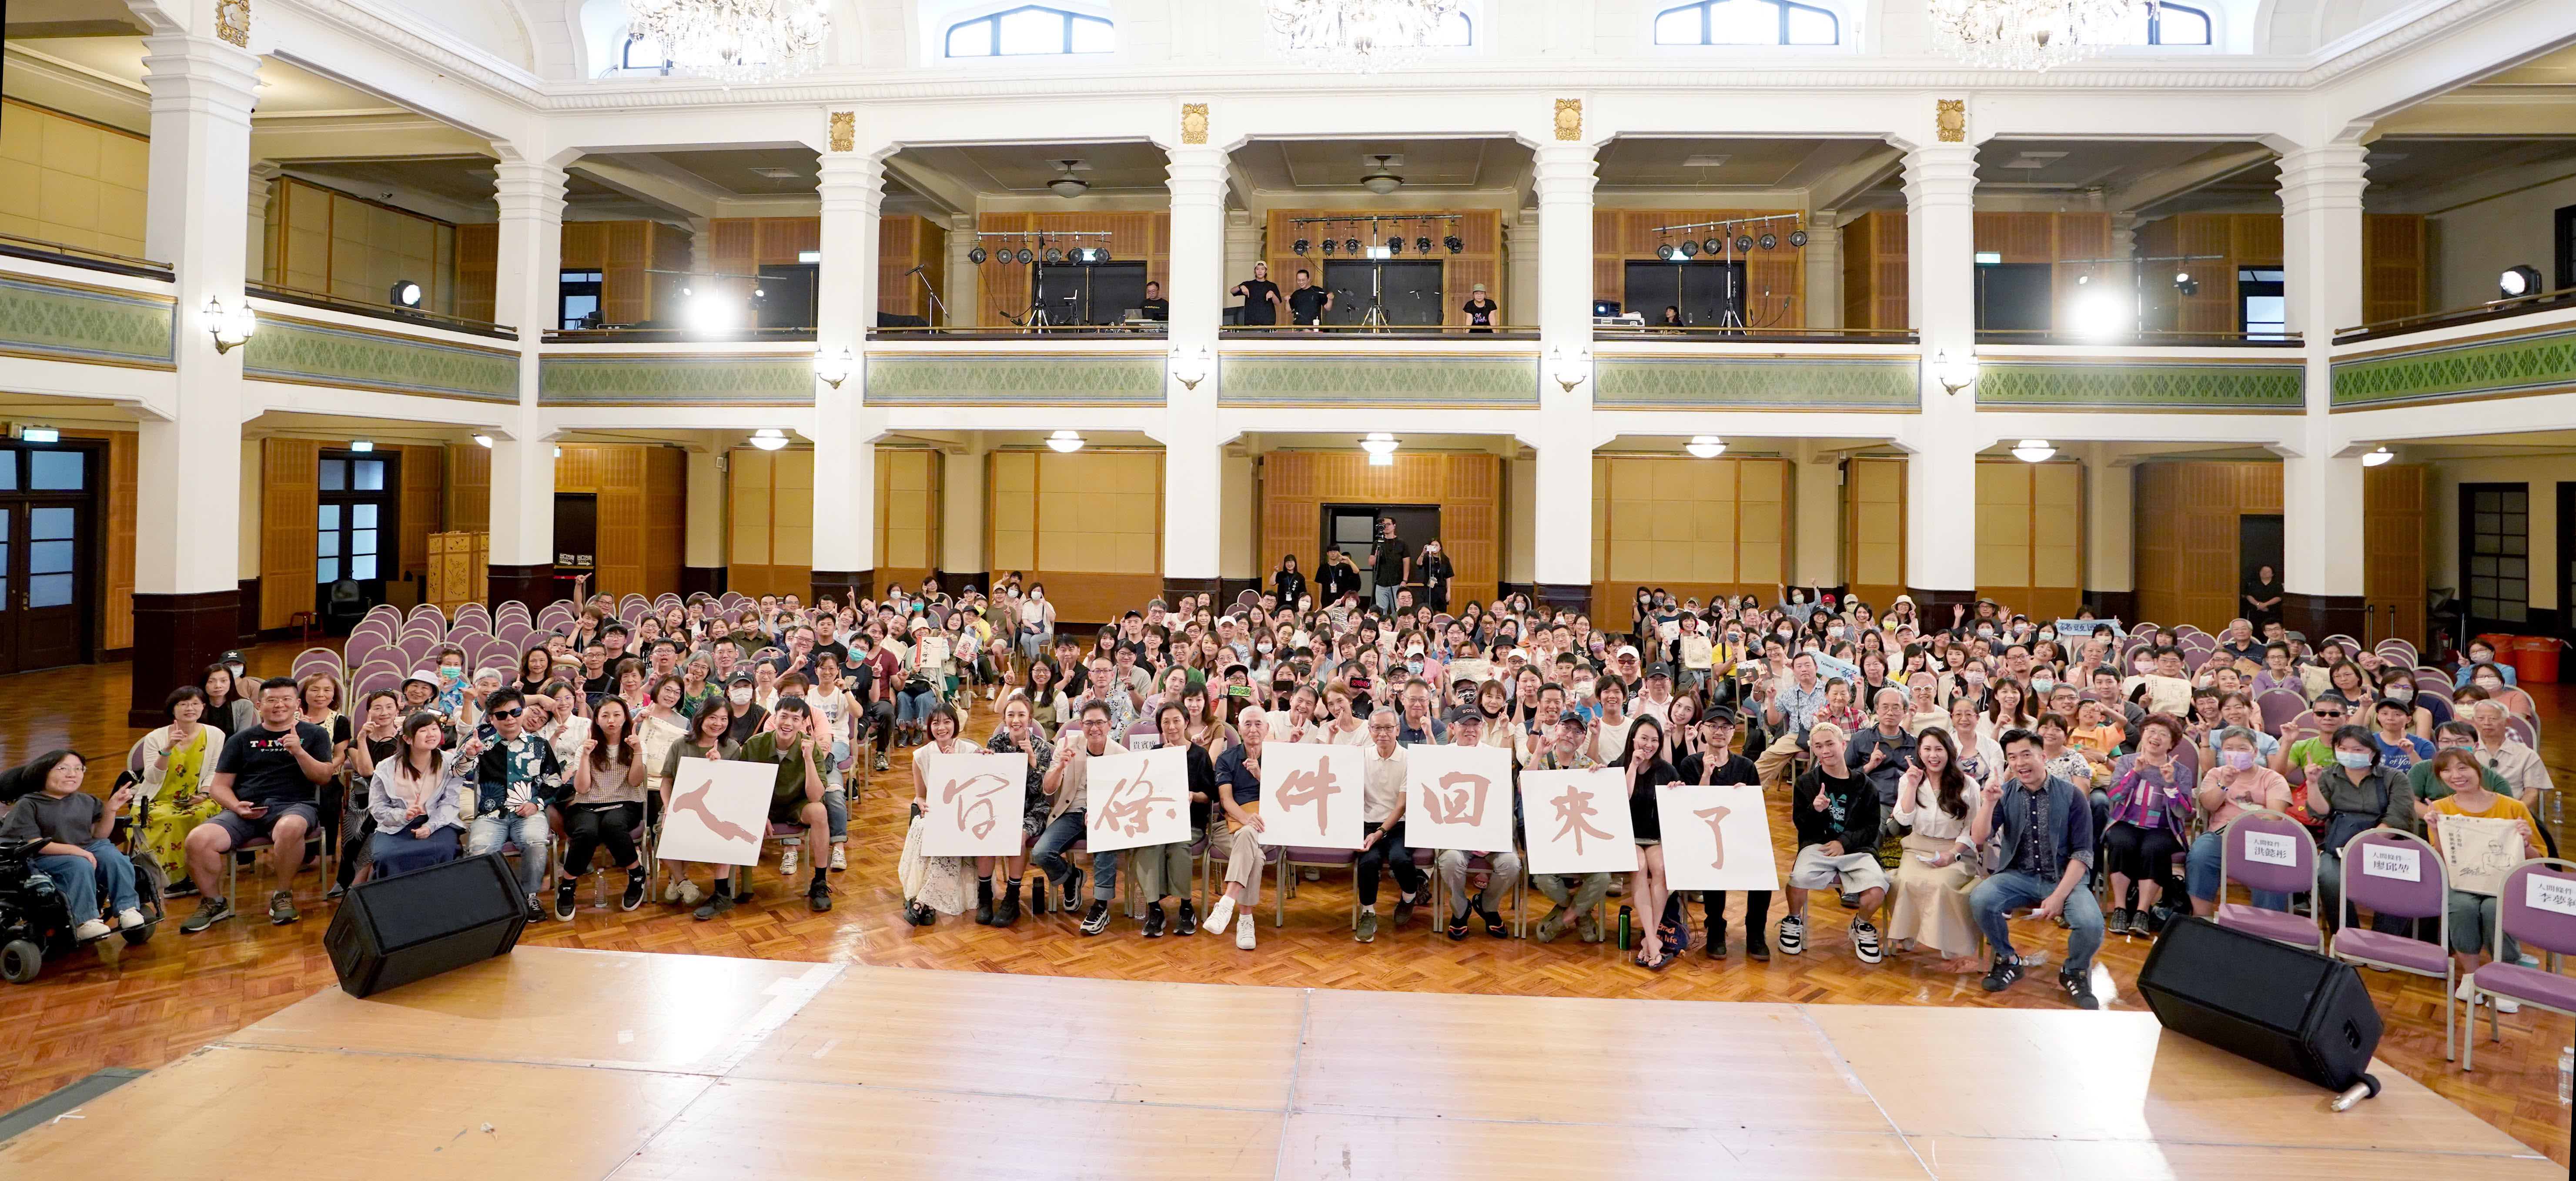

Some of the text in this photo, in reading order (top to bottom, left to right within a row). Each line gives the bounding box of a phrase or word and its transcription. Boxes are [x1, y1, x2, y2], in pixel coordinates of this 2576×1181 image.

[672, 779, 758, 844] 人
[1094, 759, 1177, 837] 條
[1276, 755, 1341, 836] 件
[1422, 772, 1492, 826] 回
[1550, 785, 1615, 856] 來
[1693, 806, 1731, 870] 了
[1665, 934, 1678, 945] life
